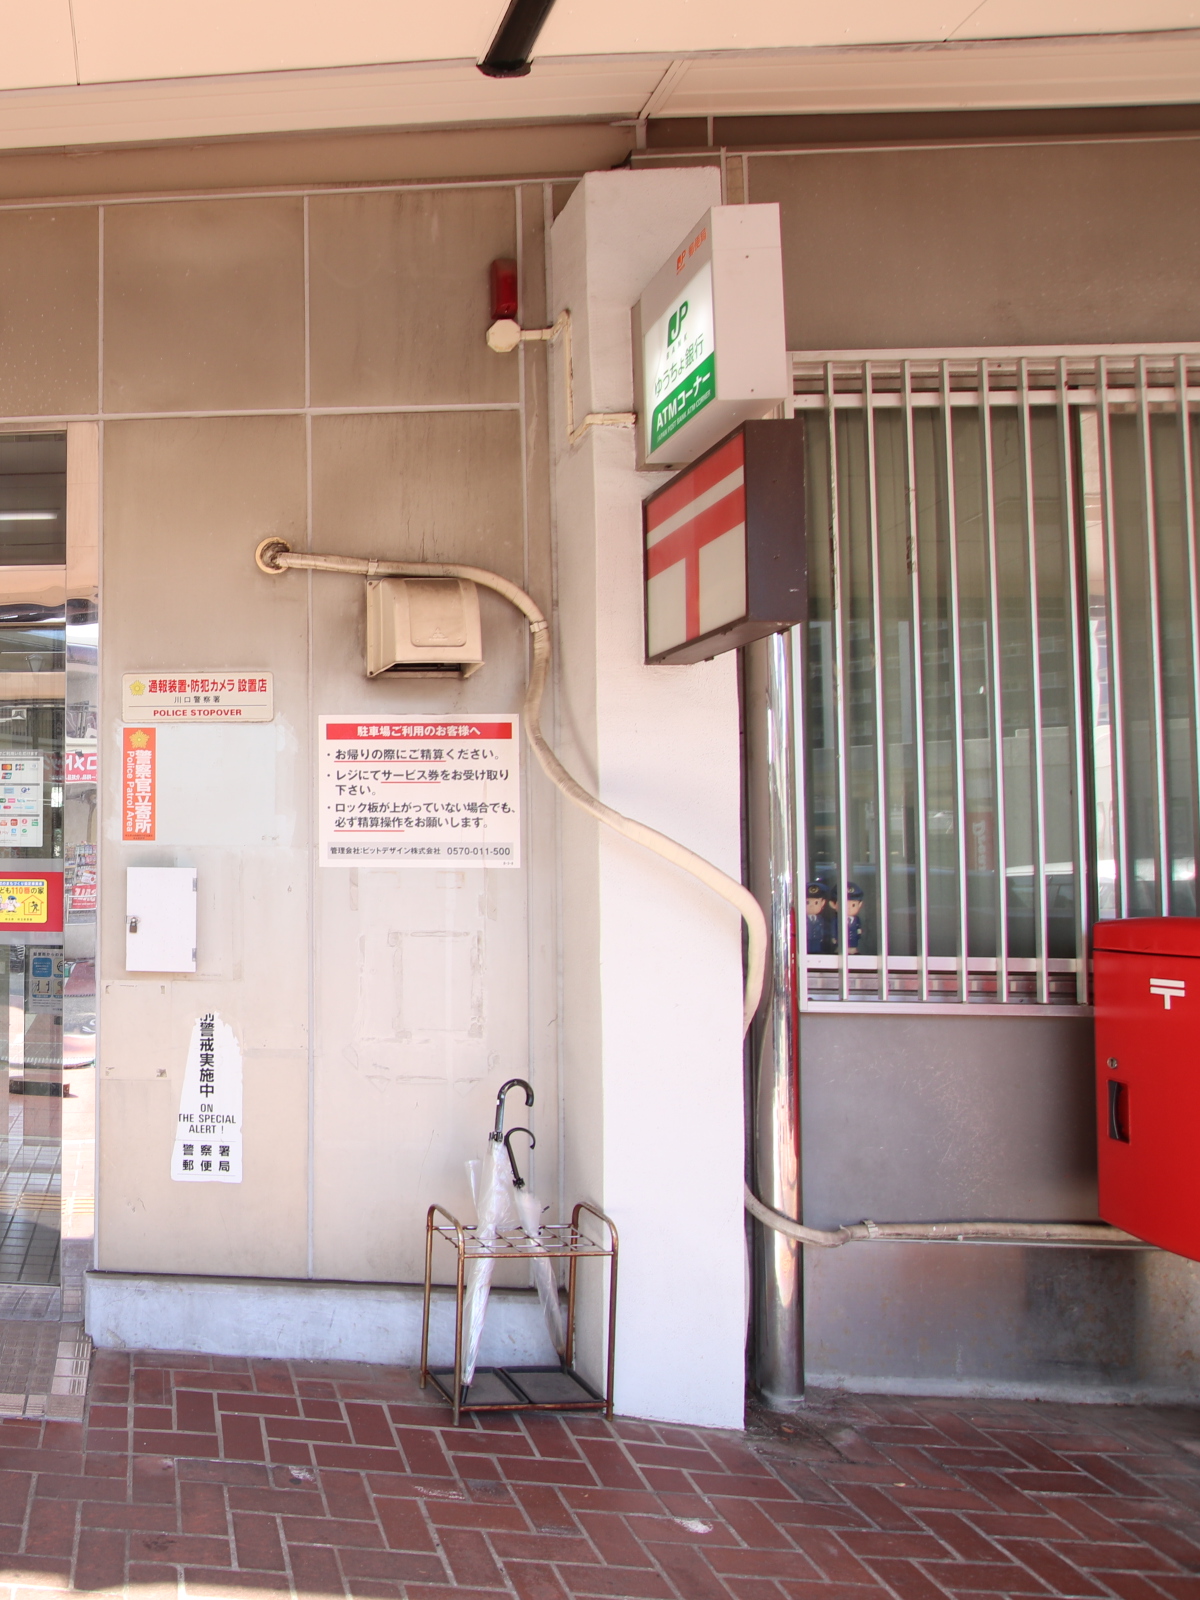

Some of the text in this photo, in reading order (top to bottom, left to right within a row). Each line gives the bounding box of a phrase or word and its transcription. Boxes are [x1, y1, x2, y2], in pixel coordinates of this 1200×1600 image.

[666, 332, 688, 360] BANK
[654, 333, 704, 398] ゆうちょ銀行
[656, 372, 711, 432] ATMコーナー
[238, 678, 267, 693] 設置店
[174, 695, 221, 704] 川口警察署
[153, 709, 188, 717] POLICE
[357, 725, 481, 737] 駐車場ご利用のお客様へ
[126, 751, 135, 832] Police Patrol Area
[135, 750, 152, 833] 警察官立寄所
[447, 847, 511, 856] 0570-011-500
[200, 1104, 213, 1112] ON
[199, 1114, 236, 1124] SPECIAL
[189, 1125, 216, 1134] ALERT
[183, 1144, 230, 1157] 警察署
[182, 1160, 230, 1172] 郵便局
